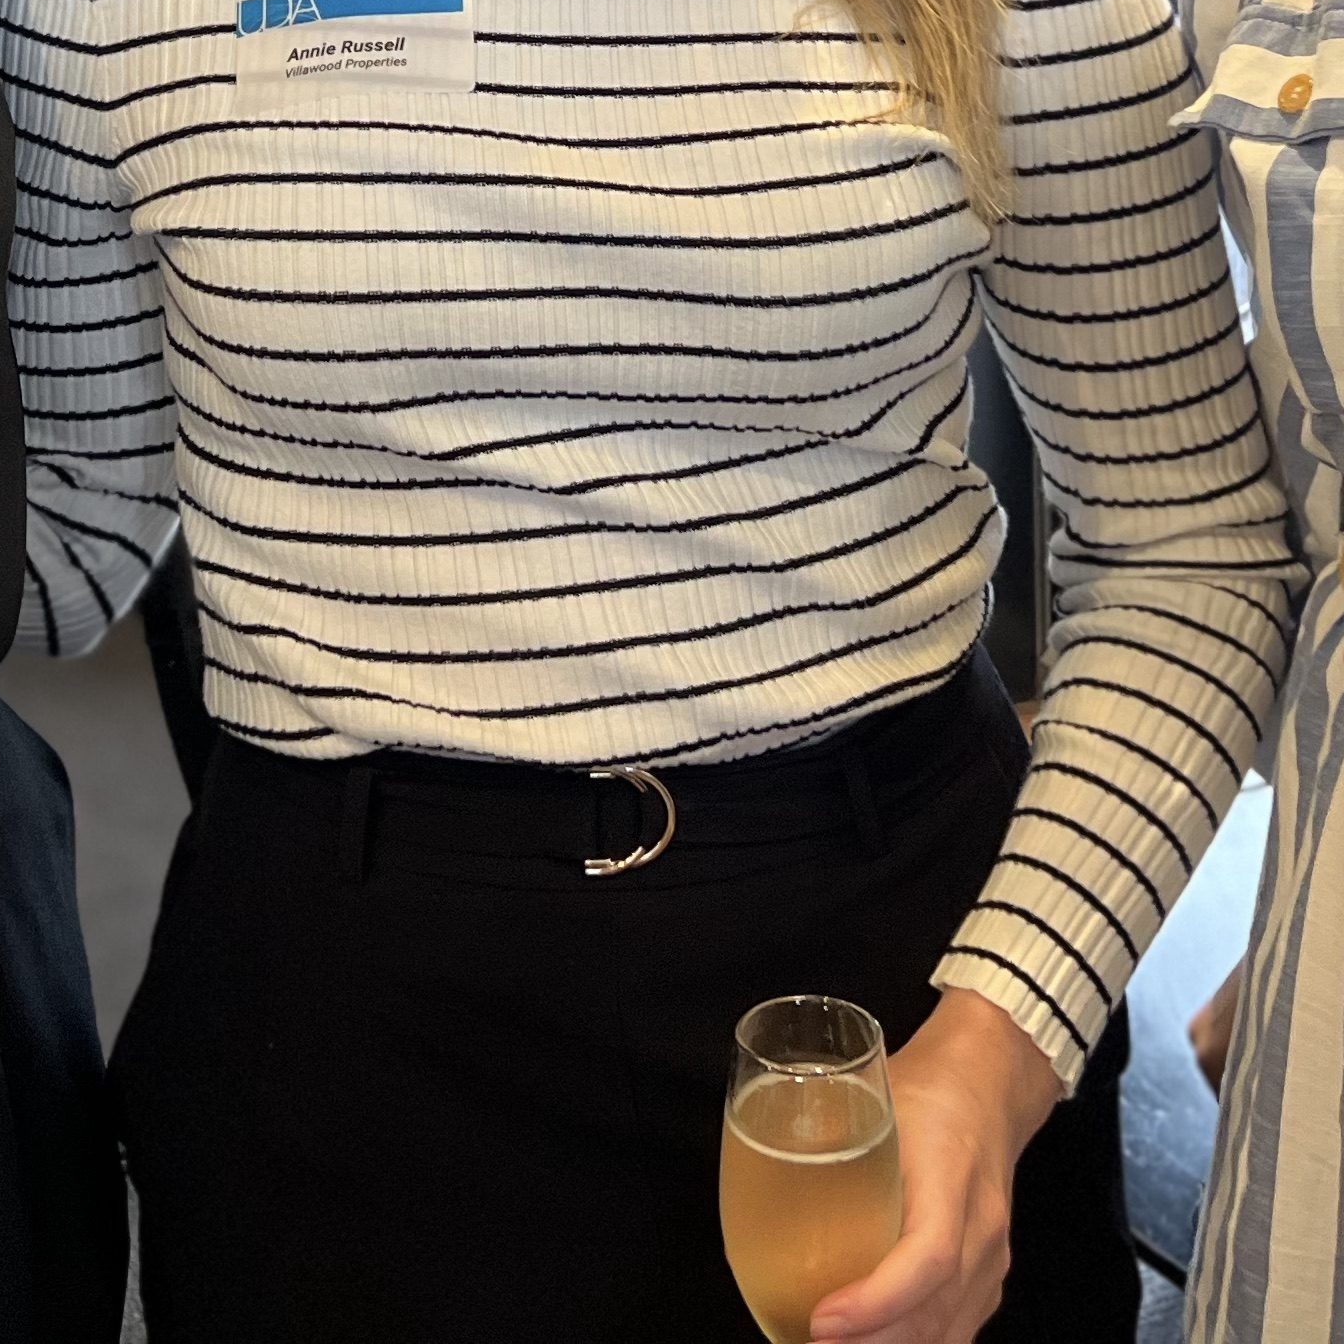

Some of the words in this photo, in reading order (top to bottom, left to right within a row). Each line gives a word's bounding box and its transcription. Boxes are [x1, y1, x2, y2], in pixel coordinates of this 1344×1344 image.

[286, 42, 336, 63] Annie
[340, 36, 406, 54] Russell
[285, 59, 343, 79] Villawood
[344, 56, 408, 70] Properties
